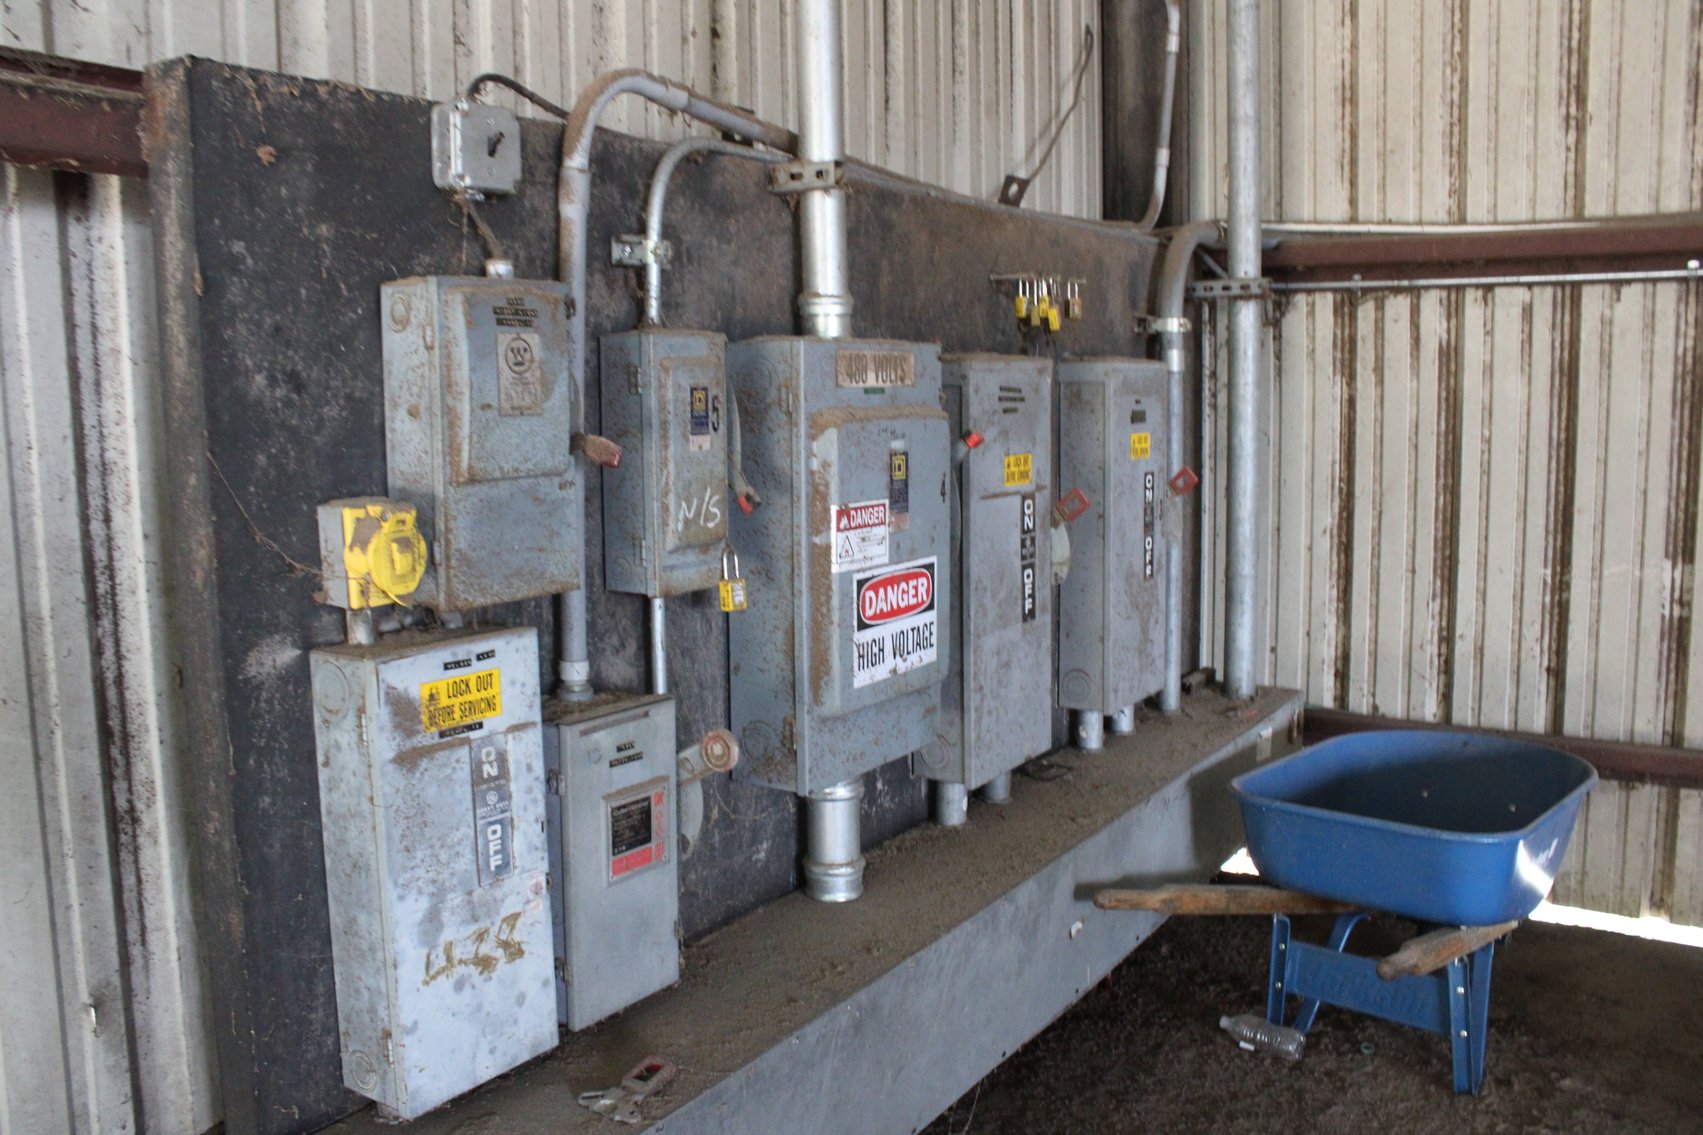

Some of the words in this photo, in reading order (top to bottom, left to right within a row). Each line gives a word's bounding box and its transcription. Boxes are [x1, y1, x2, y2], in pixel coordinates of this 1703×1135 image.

[844, 353, 868, 384] 480
[873, 353, 907, 384] VOLTS
[711, 394, 720, 432] 5
[1145, 474, 1153, 502] ON
[850, 506, 885, 529] DANGER
[1024, 499, 1033, 530] ON
[1145, 536, 1153, 577] OFF
[865, 577, 928, 617] DANGER
[1024, 568, 1033, 614] OFF
[857, 636, 885, 671] HIGH
[891, 622, 935, 660] VOLTAGE
[446, 677, 472, 699] LOCK
[475, 672, 493, 693] OUT
[459, 695, 497, 720] SERVICING
[481, 746, 498, 778] ON
[487, 824, 502, 872] OFF
